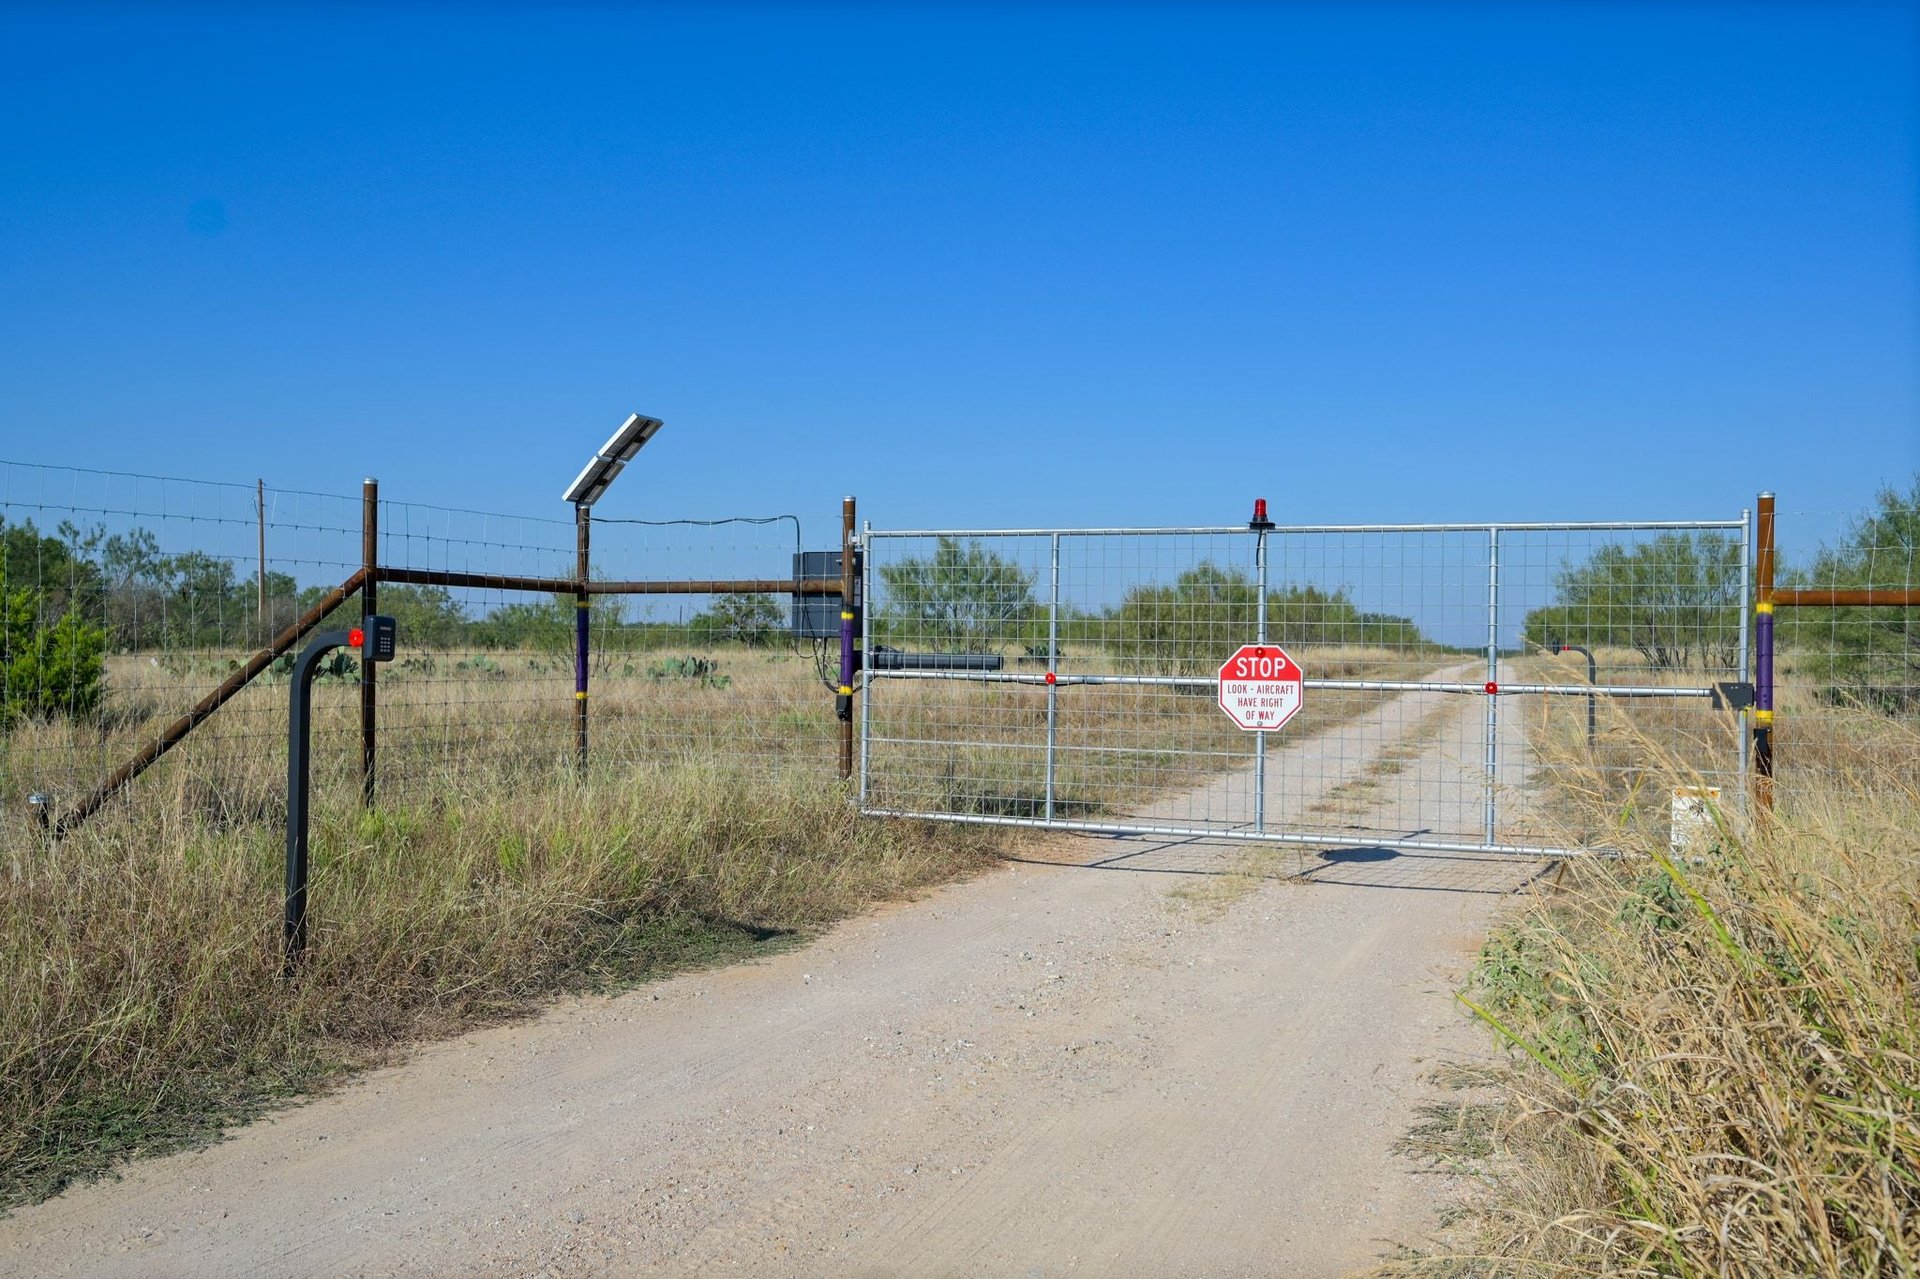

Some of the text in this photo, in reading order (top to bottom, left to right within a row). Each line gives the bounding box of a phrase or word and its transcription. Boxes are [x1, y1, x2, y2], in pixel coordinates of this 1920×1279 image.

[1236, 657, 1286, 677] STOP
[1227, 684, 1247, 694] LOOK
[1256, 685, 1294, 695] AIRCRAFT
[1237, 697, 1283, 708] HAVE RIGHT
[1245, 710, 1275, 721] OF WAY
